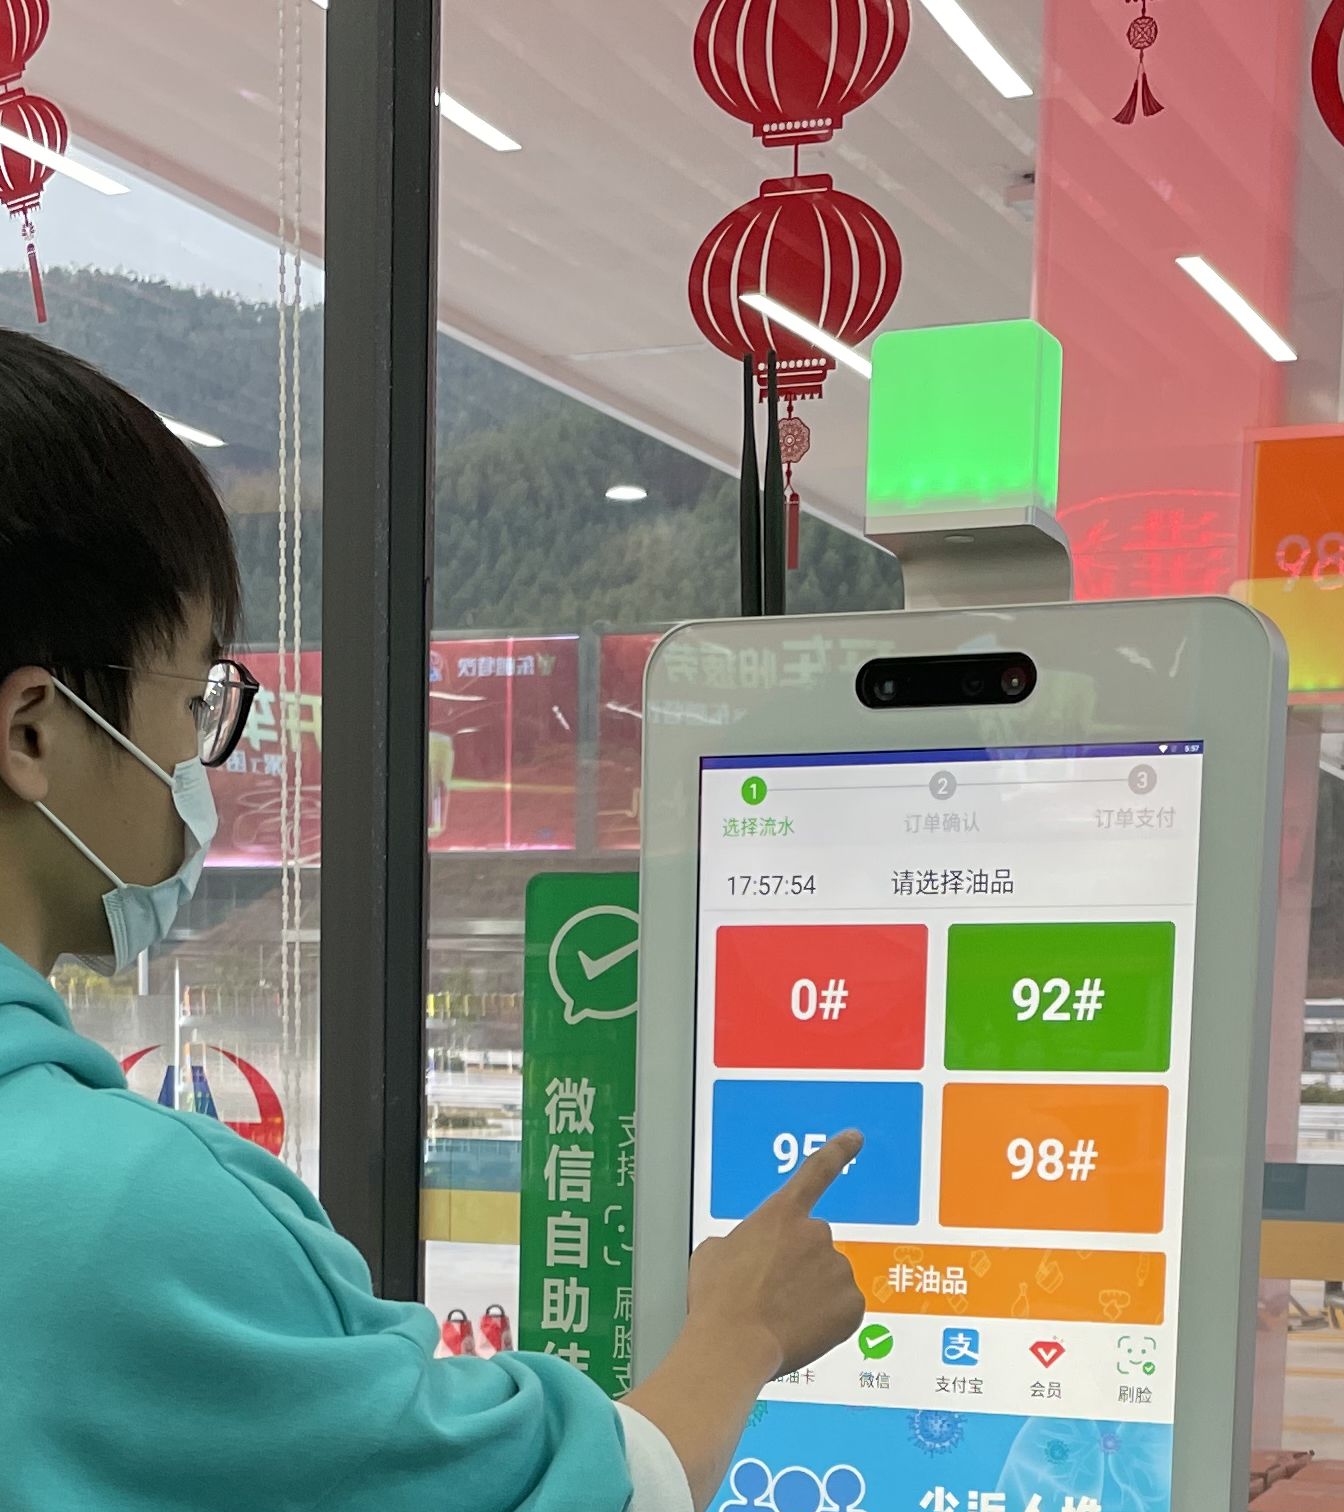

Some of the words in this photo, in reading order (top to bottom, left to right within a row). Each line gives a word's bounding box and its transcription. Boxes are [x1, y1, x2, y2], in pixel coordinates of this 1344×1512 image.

[722, 816, 795, 838] 选择流水
[904, 811, 981, 834] 订单确认
[1094, 806, 1176, 829] 订单支付
[727, 873, 817, 897] 17:57:54
[891, 869, 1014, 896] 请选择油品
[789, 977, 849, 1021] 0#
[1011, 977, 1105, 1021] 92#
[773, 1132, 856, 1175] 95
[1006, 1138, 1099, 1182] 98#
[887, 1264, 968, 1295] 非油品
[859, 1371, 891, 1390] 微信
[935, 1376, 984, 1395] 支付宝
[1030, 1381, 1062, 1399] 会员
[1118, 1385, 1152, 1405] 刷脸
